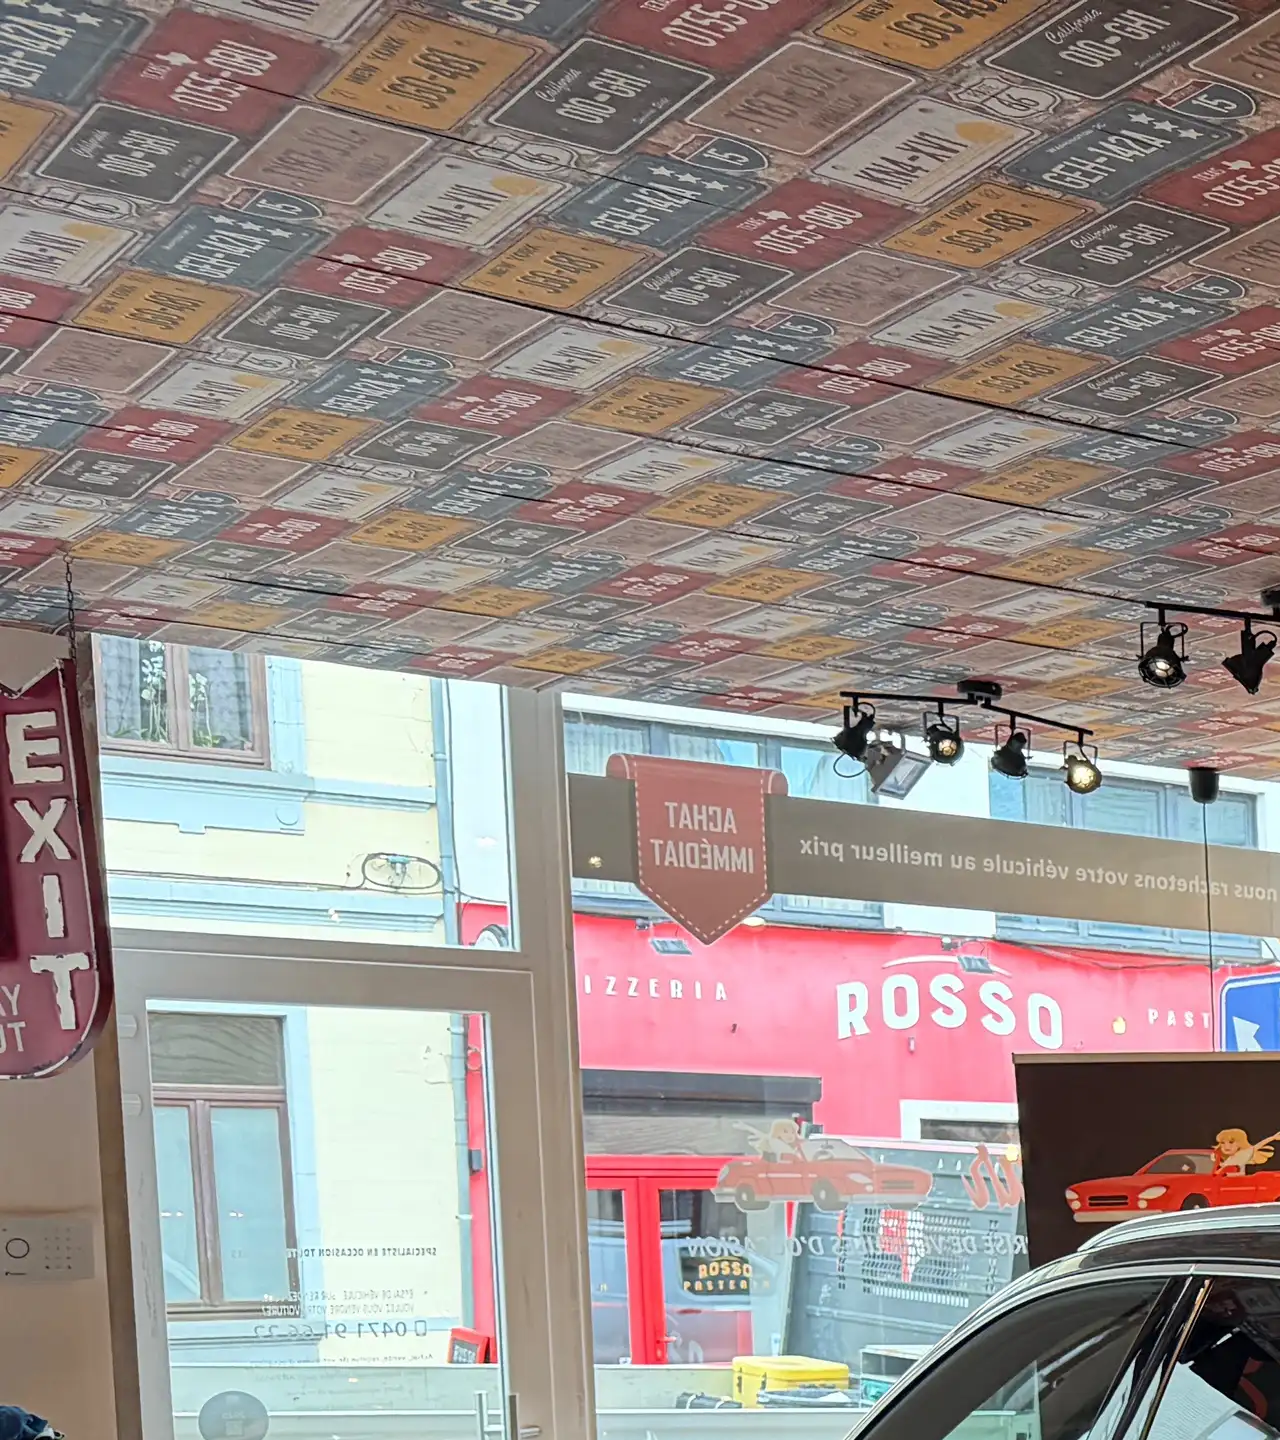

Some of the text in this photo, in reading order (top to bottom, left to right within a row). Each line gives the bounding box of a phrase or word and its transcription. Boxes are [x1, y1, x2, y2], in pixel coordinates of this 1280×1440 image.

[5, 711, 89, 1030] EXIT
[585, 974, 727, 1002] IZZERIA
[836, 973, 1064, 1050] ROSSO
[1147, 1008, 1211, 1029] PAST
[699, 1261, 753, 1278] ROSSO
